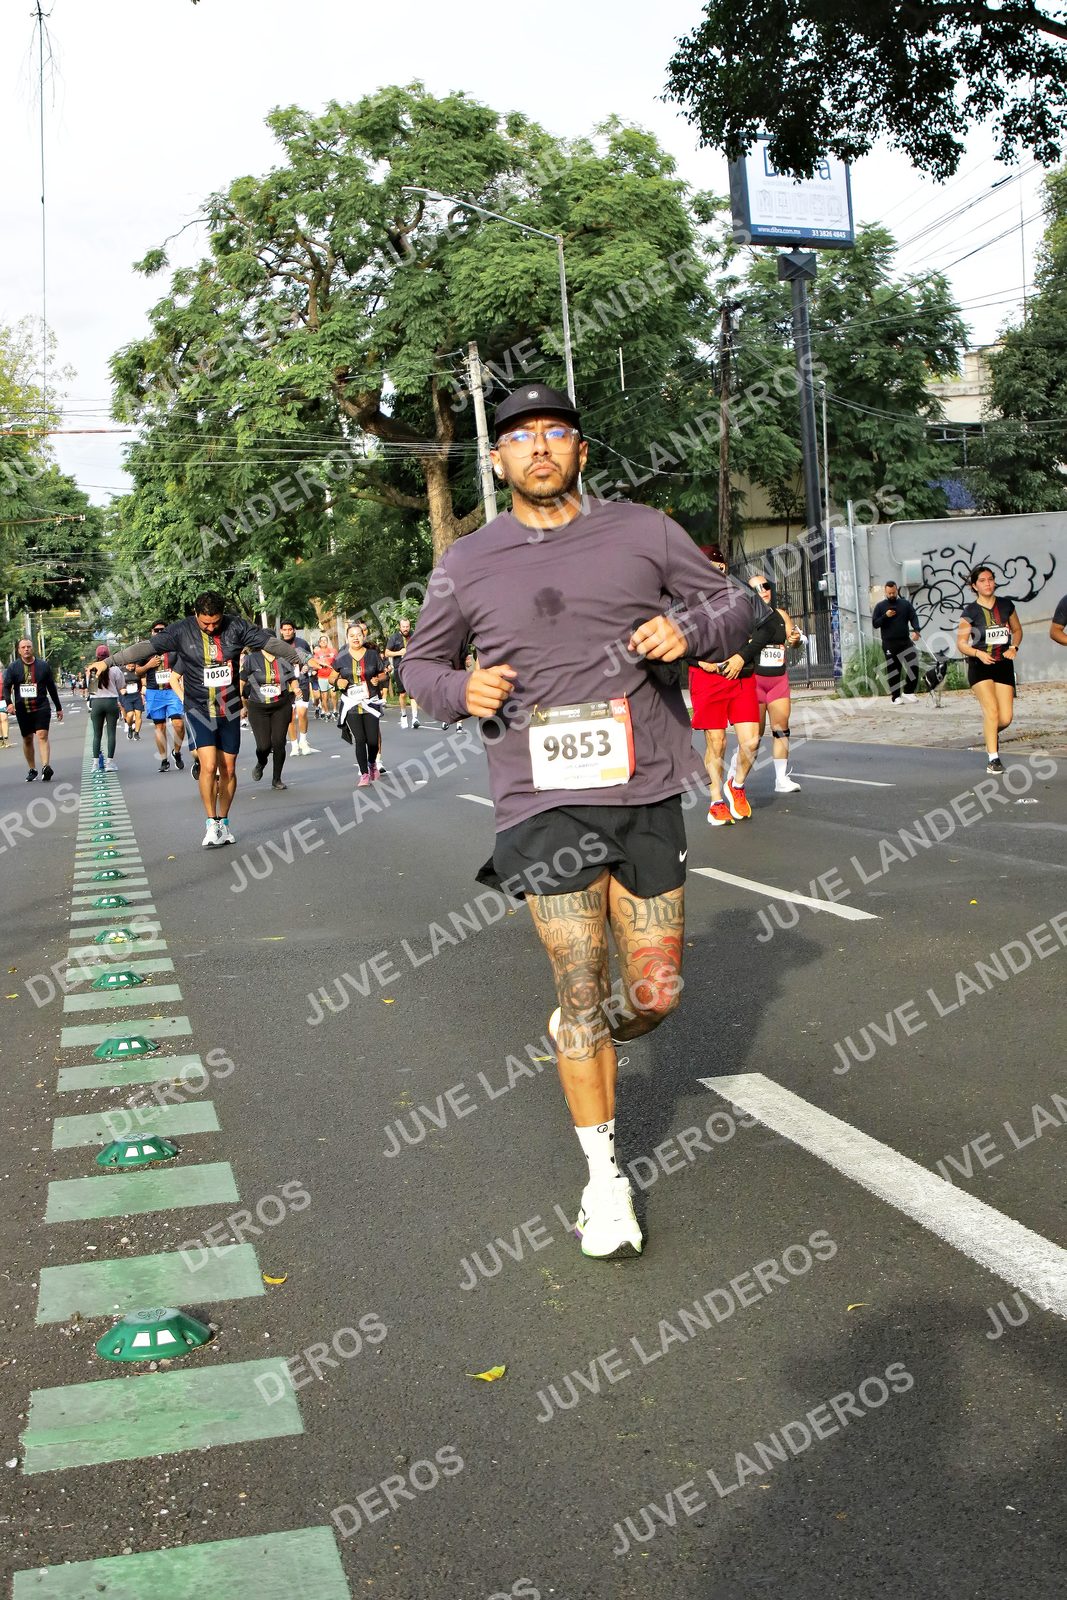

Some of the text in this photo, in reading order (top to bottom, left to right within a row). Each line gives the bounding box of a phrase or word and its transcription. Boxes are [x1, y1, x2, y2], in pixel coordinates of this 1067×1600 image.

[922, 542, 977, 564] TOY
[987, 630, 1009, 639] 10720
[764, 650, 781, 659] 8160
[206, 671, 230, 680] 10505
[543, 730, 612, 761] 9853
